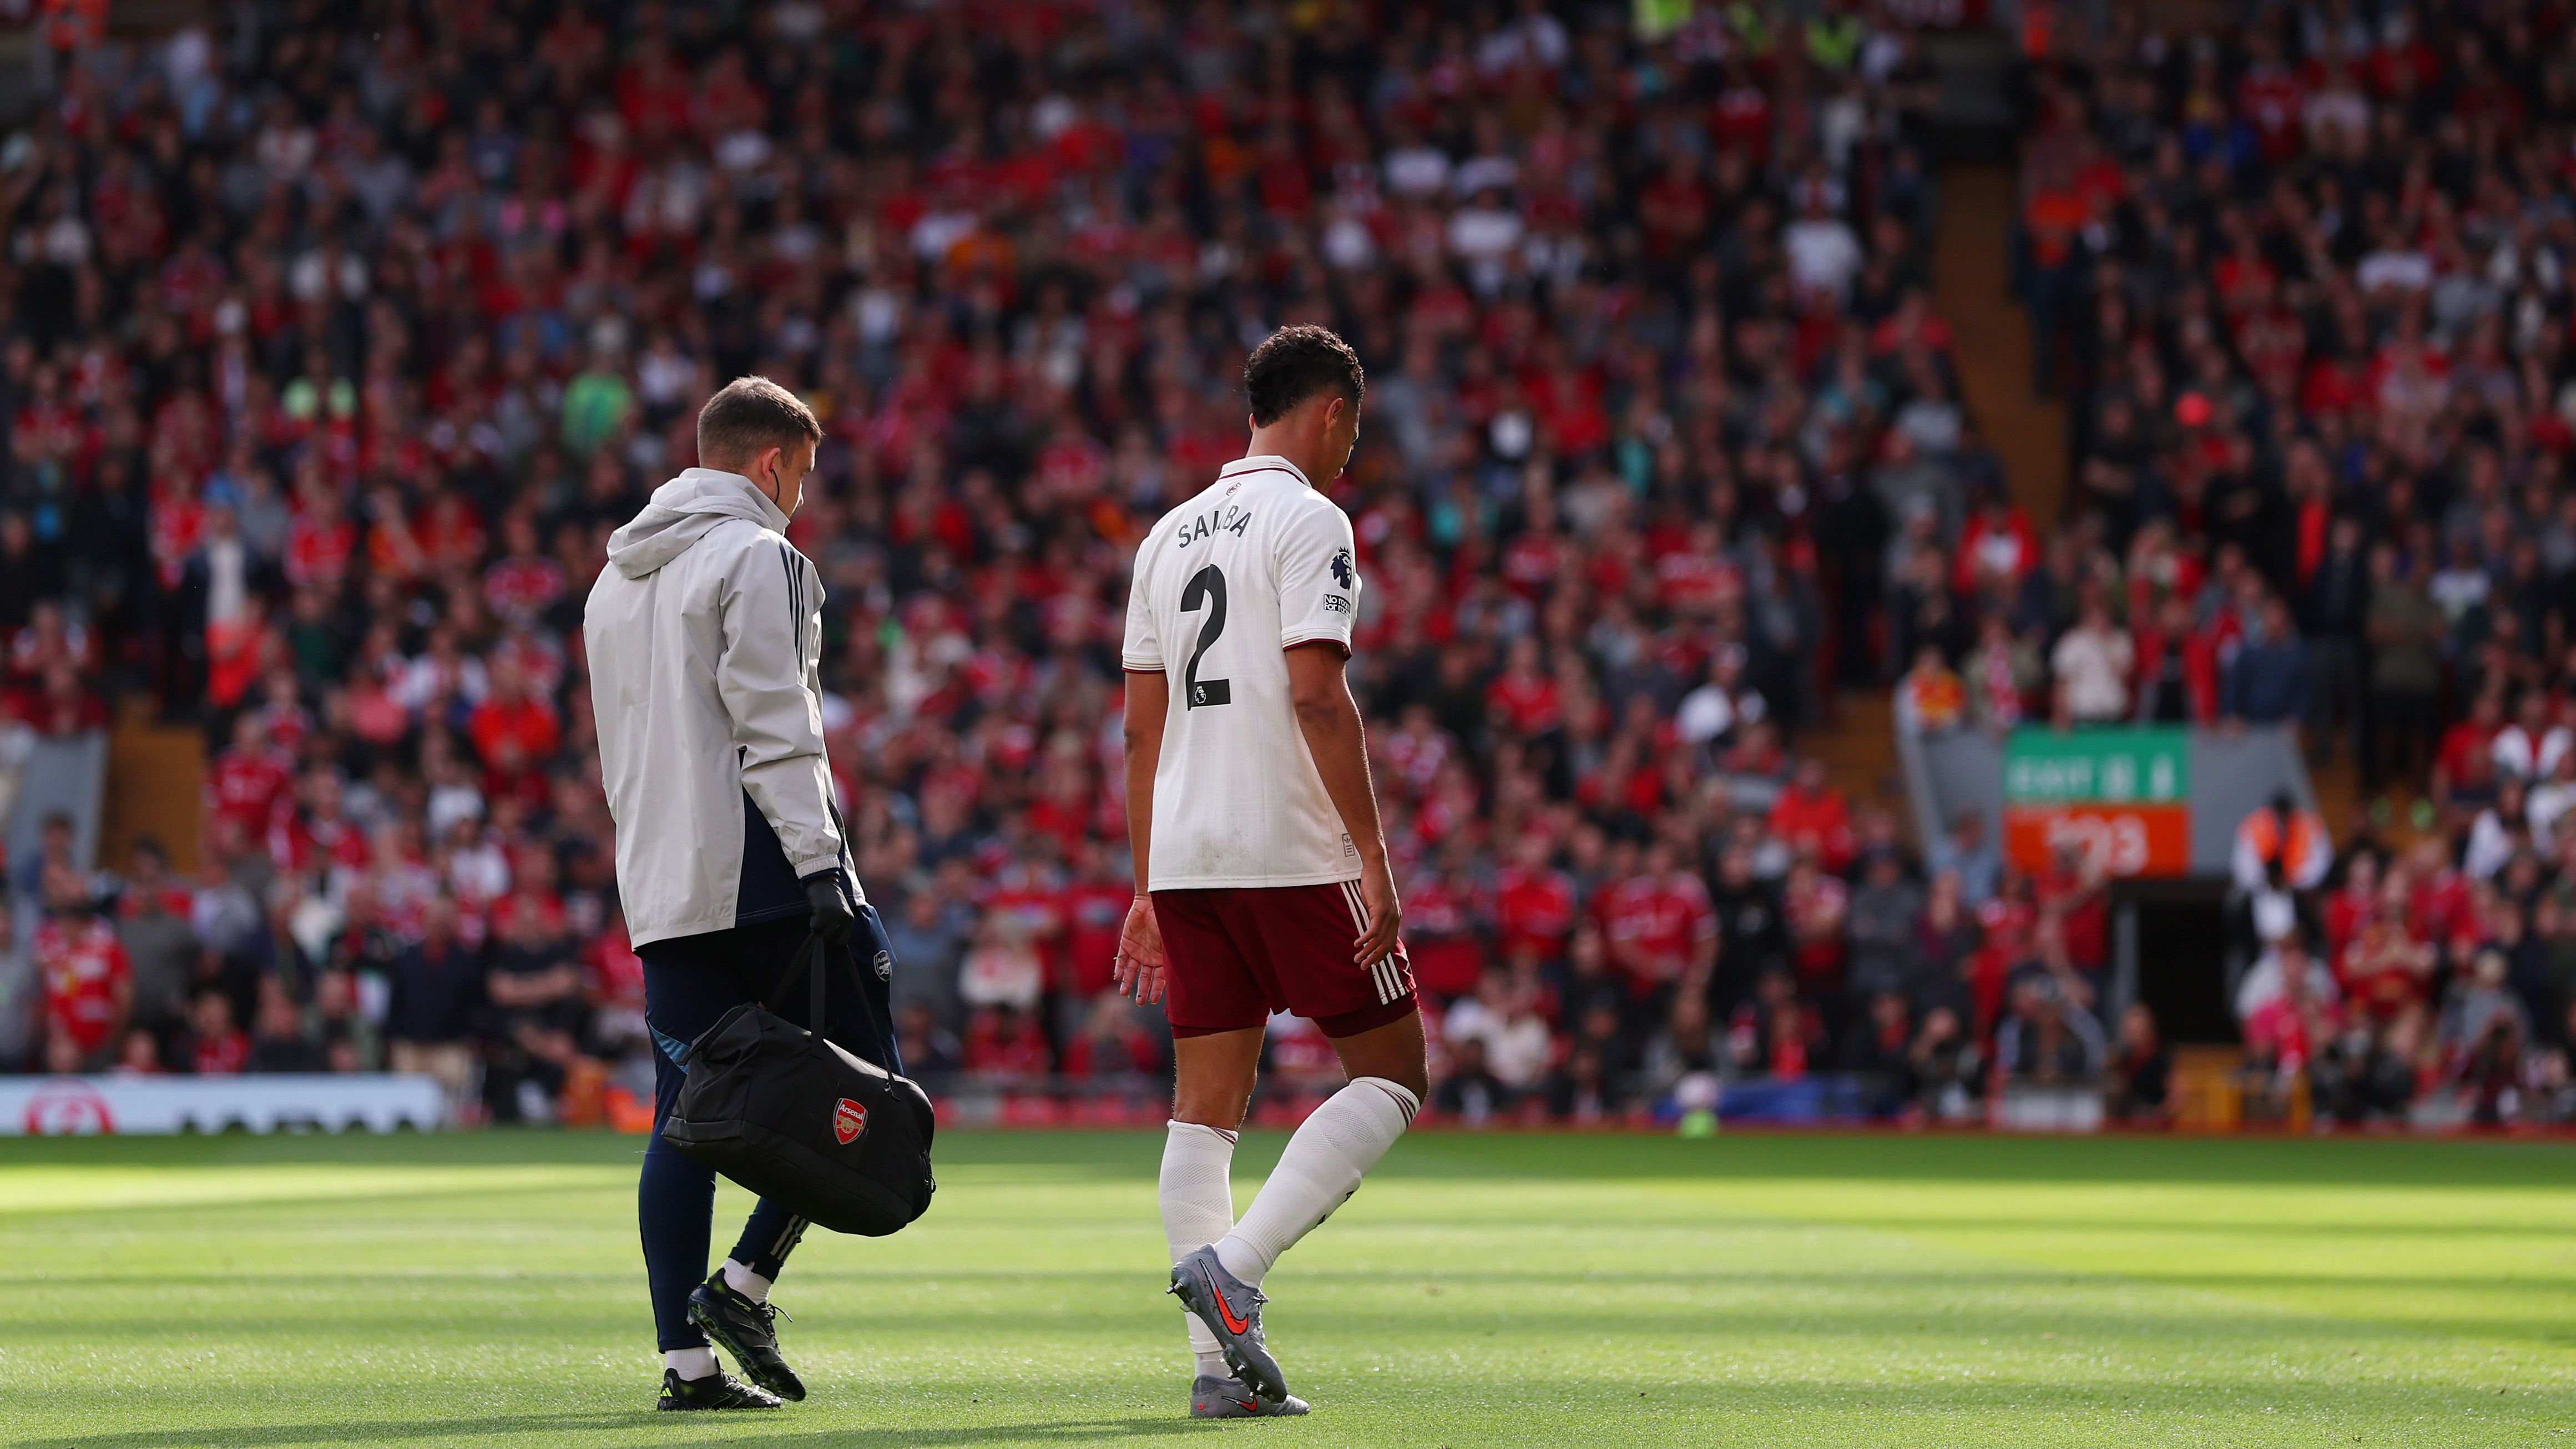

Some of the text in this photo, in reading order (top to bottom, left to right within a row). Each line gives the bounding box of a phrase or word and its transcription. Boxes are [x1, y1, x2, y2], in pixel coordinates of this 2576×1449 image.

[1324, 594, 1337, 603] No
[1324, 602, 1337, 610] for
[1180, 563, 1231, 711] 2
[840, 1104, 863, 1120] Arsenal
